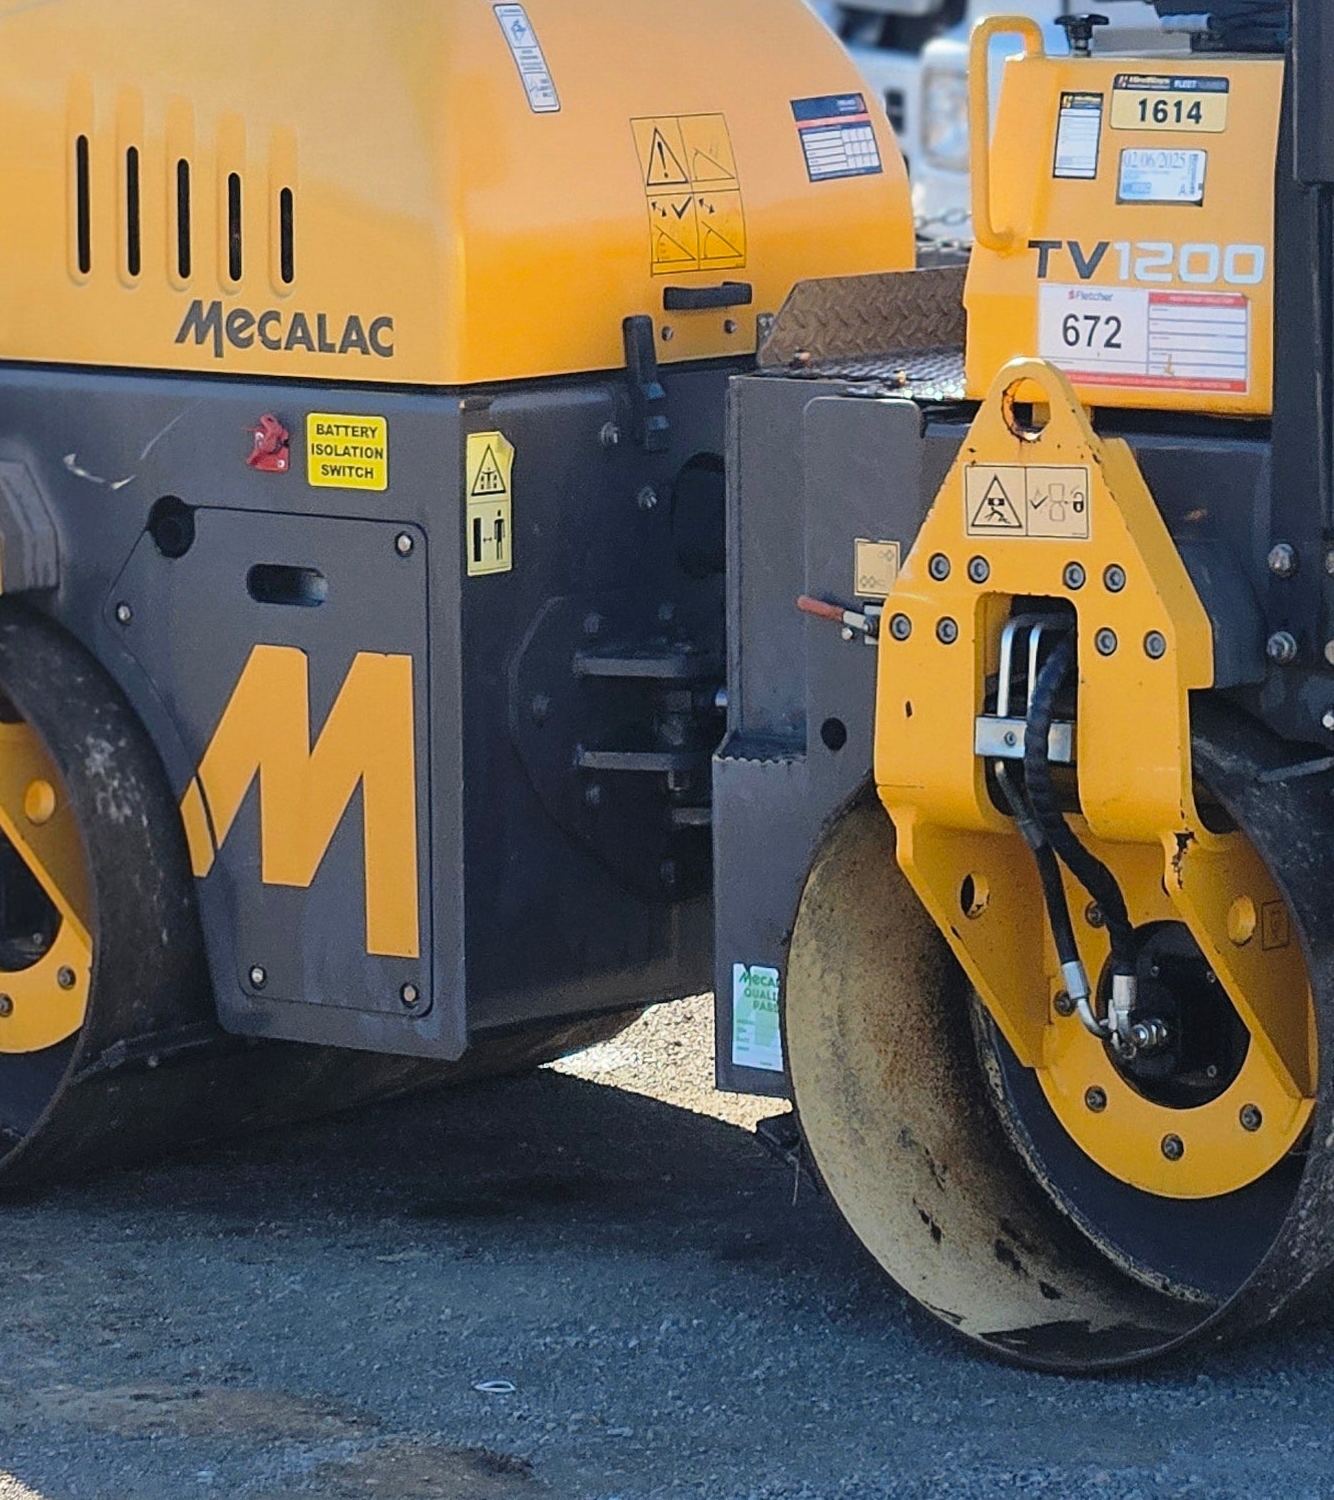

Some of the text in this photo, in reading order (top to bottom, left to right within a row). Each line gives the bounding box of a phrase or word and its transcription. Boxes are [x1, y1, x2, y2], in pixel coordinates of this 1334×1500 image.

[1138, 98, 1202, 125] 1614
[1076, 290, 1114, 301] Fletcher
[1062, 313, 1123, 349] 672
[316, 423, 379, 439] BATTERY
[311, 443, 384, 460] ISOLATION
[321, 464, 374, 479] SWITCH
